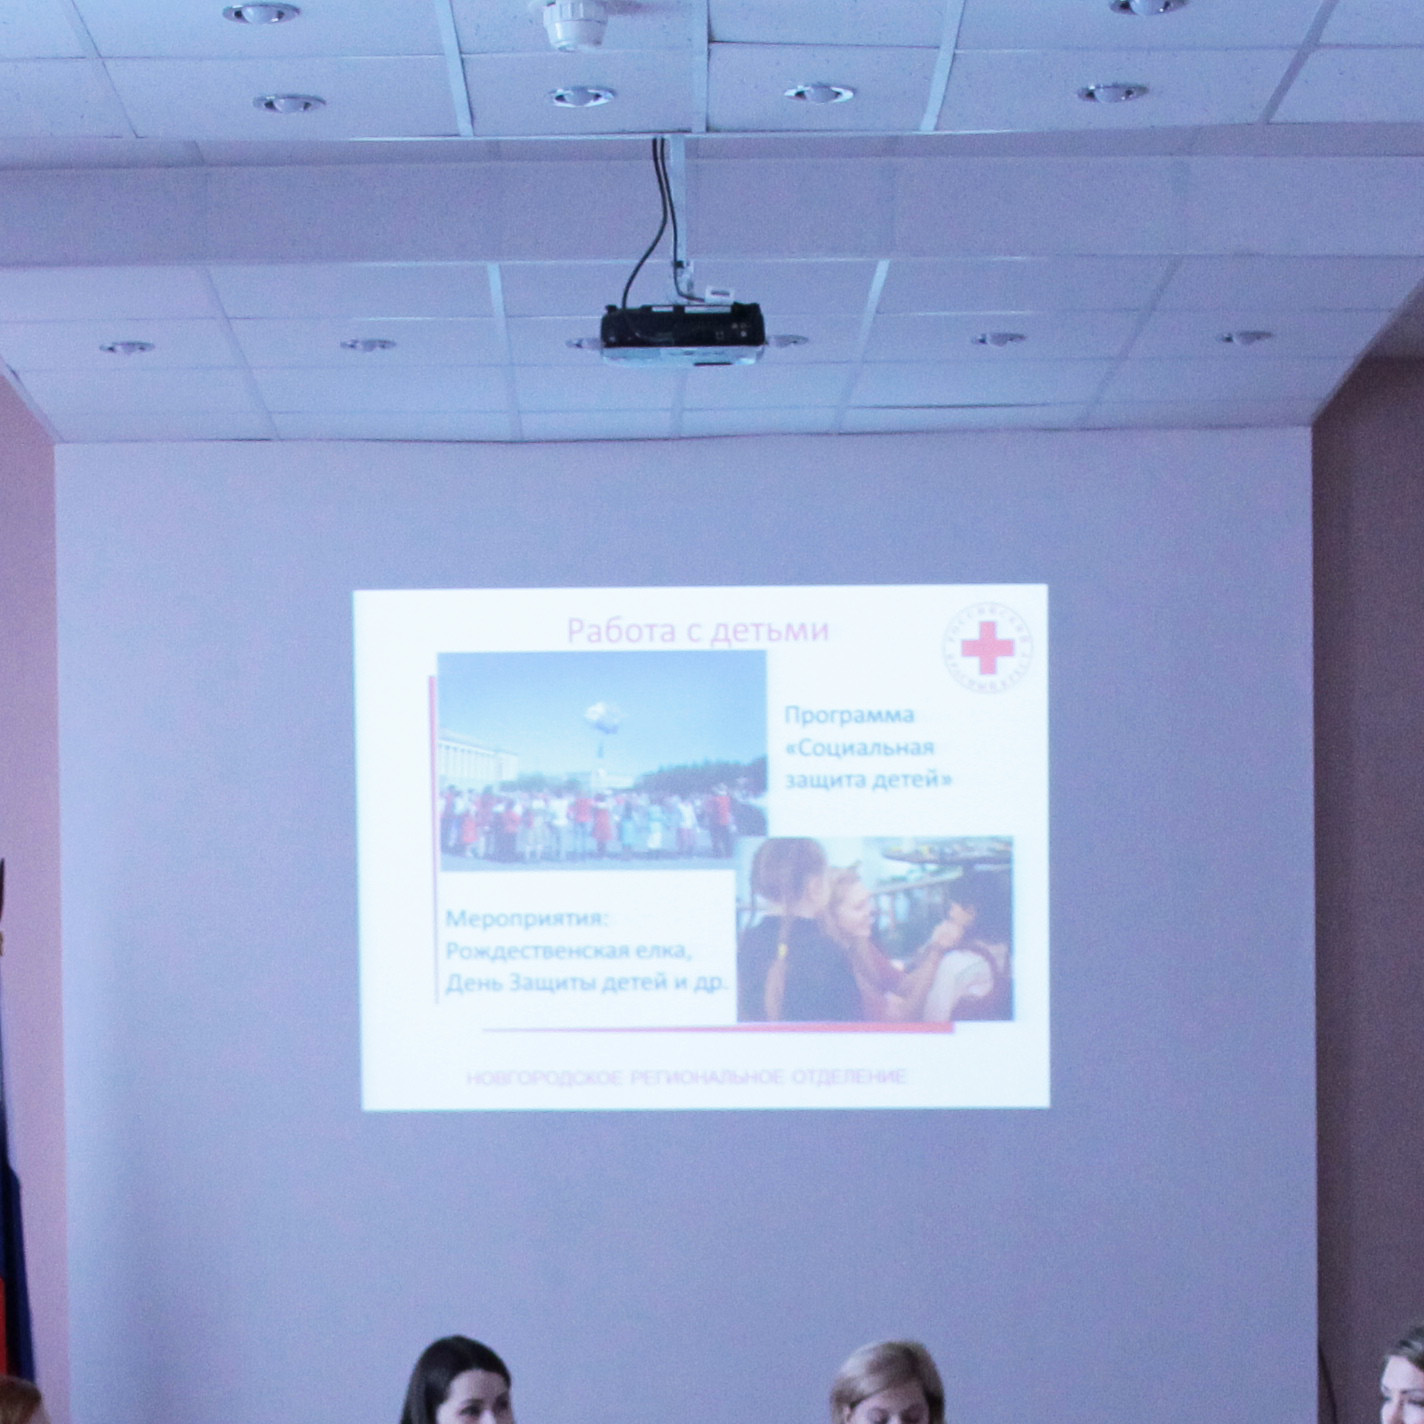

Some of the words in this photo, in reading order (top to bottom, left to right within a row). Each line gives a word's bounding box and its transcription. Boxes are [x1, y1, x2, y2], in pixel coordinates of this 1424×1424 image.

[567, 614, 677, 644] Работа
[687, 622, 703, 644] с
[710, 621, 830, 649] детьми
[784, 704, 916, 728] Программа
[786, 737, 936, 759] «Социальная
[785, 772, 867, 791] защита
[872, 767, 954, 792] детей»
[446, 909, 609, 930] Мероприятия:
[445, 940, 630, 963] Рождественская
[635, 942, 694, 962] елка,
[445, 972, 504, 996] День
[510, 972, 597, 995] Защиты
[601, 970, 668, 996] детей
[674, 975, 689, 992] и
[693, 974, 730, 996] др.
[467, 1068, 623, 1089] НОВГОРОДСКОЕ
[630, 1067, 784, 1087] РЕГИОНАЛЬНОЕ
[791, 1066, 909, 1088] ОТДЕЛЕНИЕ
